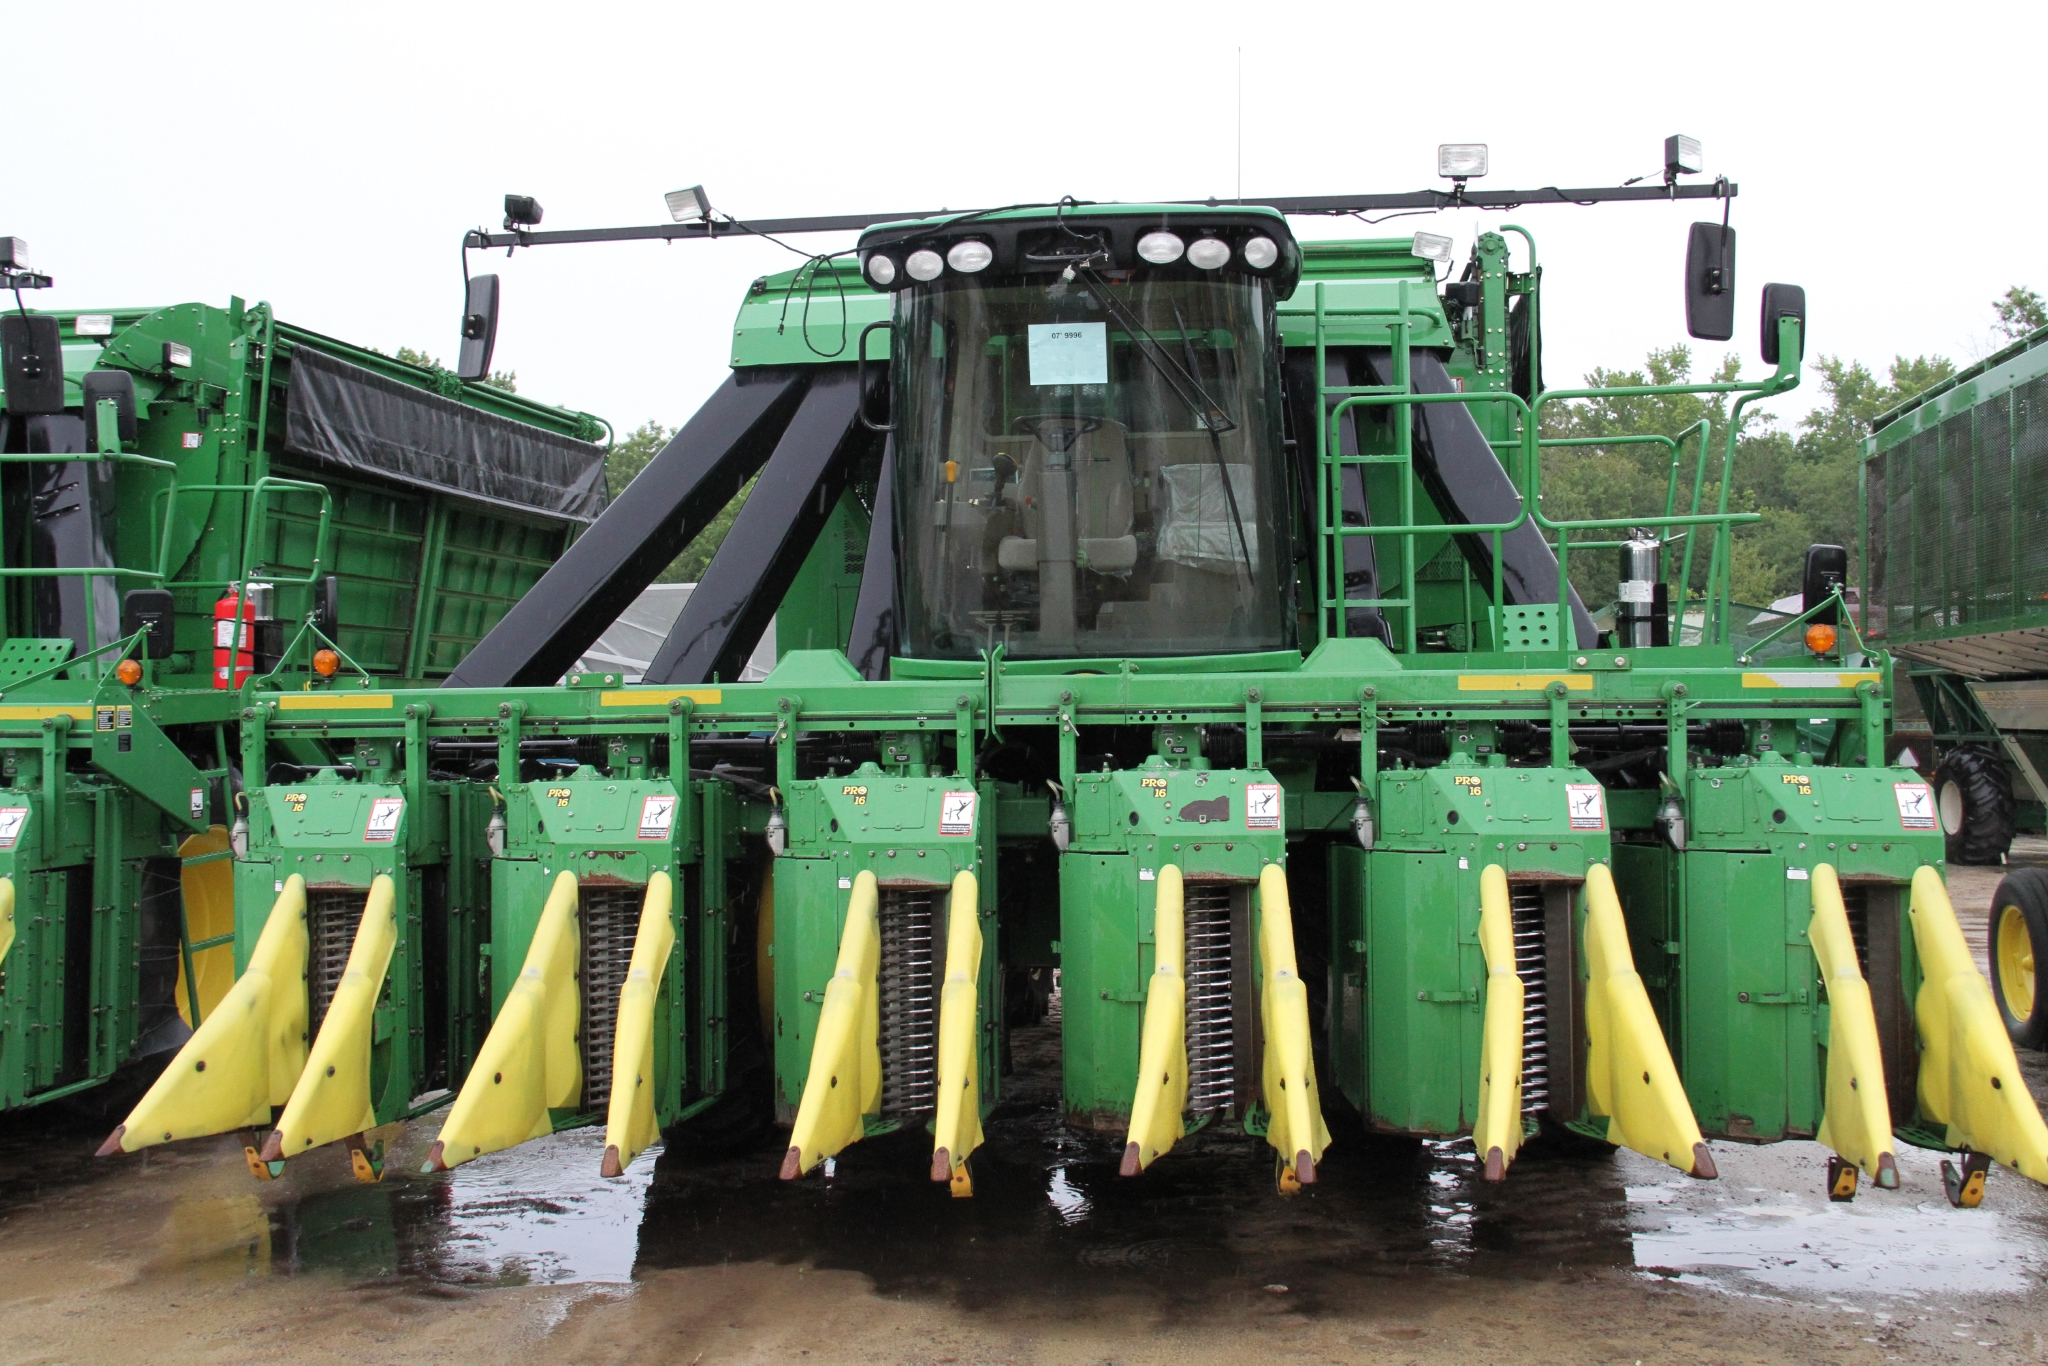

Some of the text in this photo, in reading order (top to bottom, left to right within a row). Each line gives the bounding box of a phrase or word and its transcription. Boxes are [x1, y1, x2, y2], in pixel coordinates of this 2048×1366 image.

[1140, 778, 1167, 787] PRO
[1454, 776, 1481, 785] PRO
[1782, 775, 1809, 784] PRO
[547, 788, 571, 798] PRO
[842, 786, 867, 795] PRO
[1154, 788, 1167, 798] 16
[1469, 786, 1482, 796] 16
[1798, 785, 1812, 794] 16
[283, 793, 307, 802] PRO
[854, 796, 866, 805] 16
[556, 798, 569, 807] 16
[292, 803, 305, 812] 16
